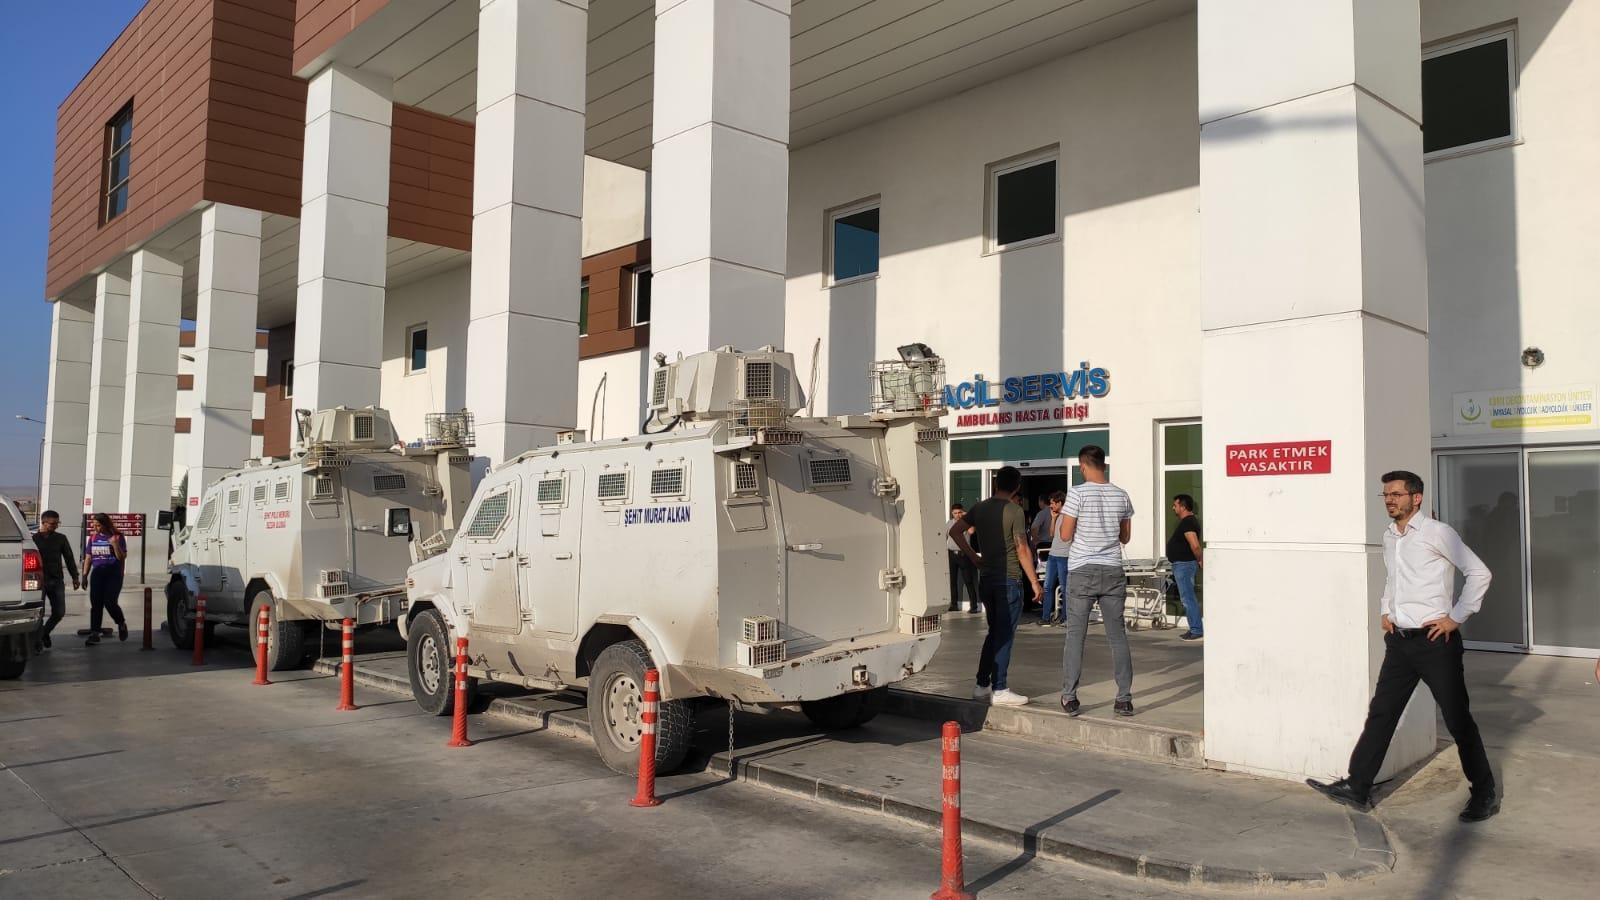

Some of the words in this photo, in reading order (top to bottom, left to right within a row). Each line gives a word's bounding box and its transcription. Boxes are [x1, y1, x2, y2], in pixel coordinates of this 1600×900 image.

[942, 373, 998, 409] ACİL
[1004, 361, 1110, 403] SERVİS
[957, 412, 1012, 427] AMBULANS
[1015, 405, 1050, 423] HASTA
[1054, 402, 1089, 422] GİRİŞİ
[1229, 448, 1268, 460] PARK
[1273, 446, 1328, 458] ETMEK
[1240, 460, 1313, 472] YASAKTIR
[644, 507, 667, 524] MURAT
[667, 505, 691, 523] ALKAN
